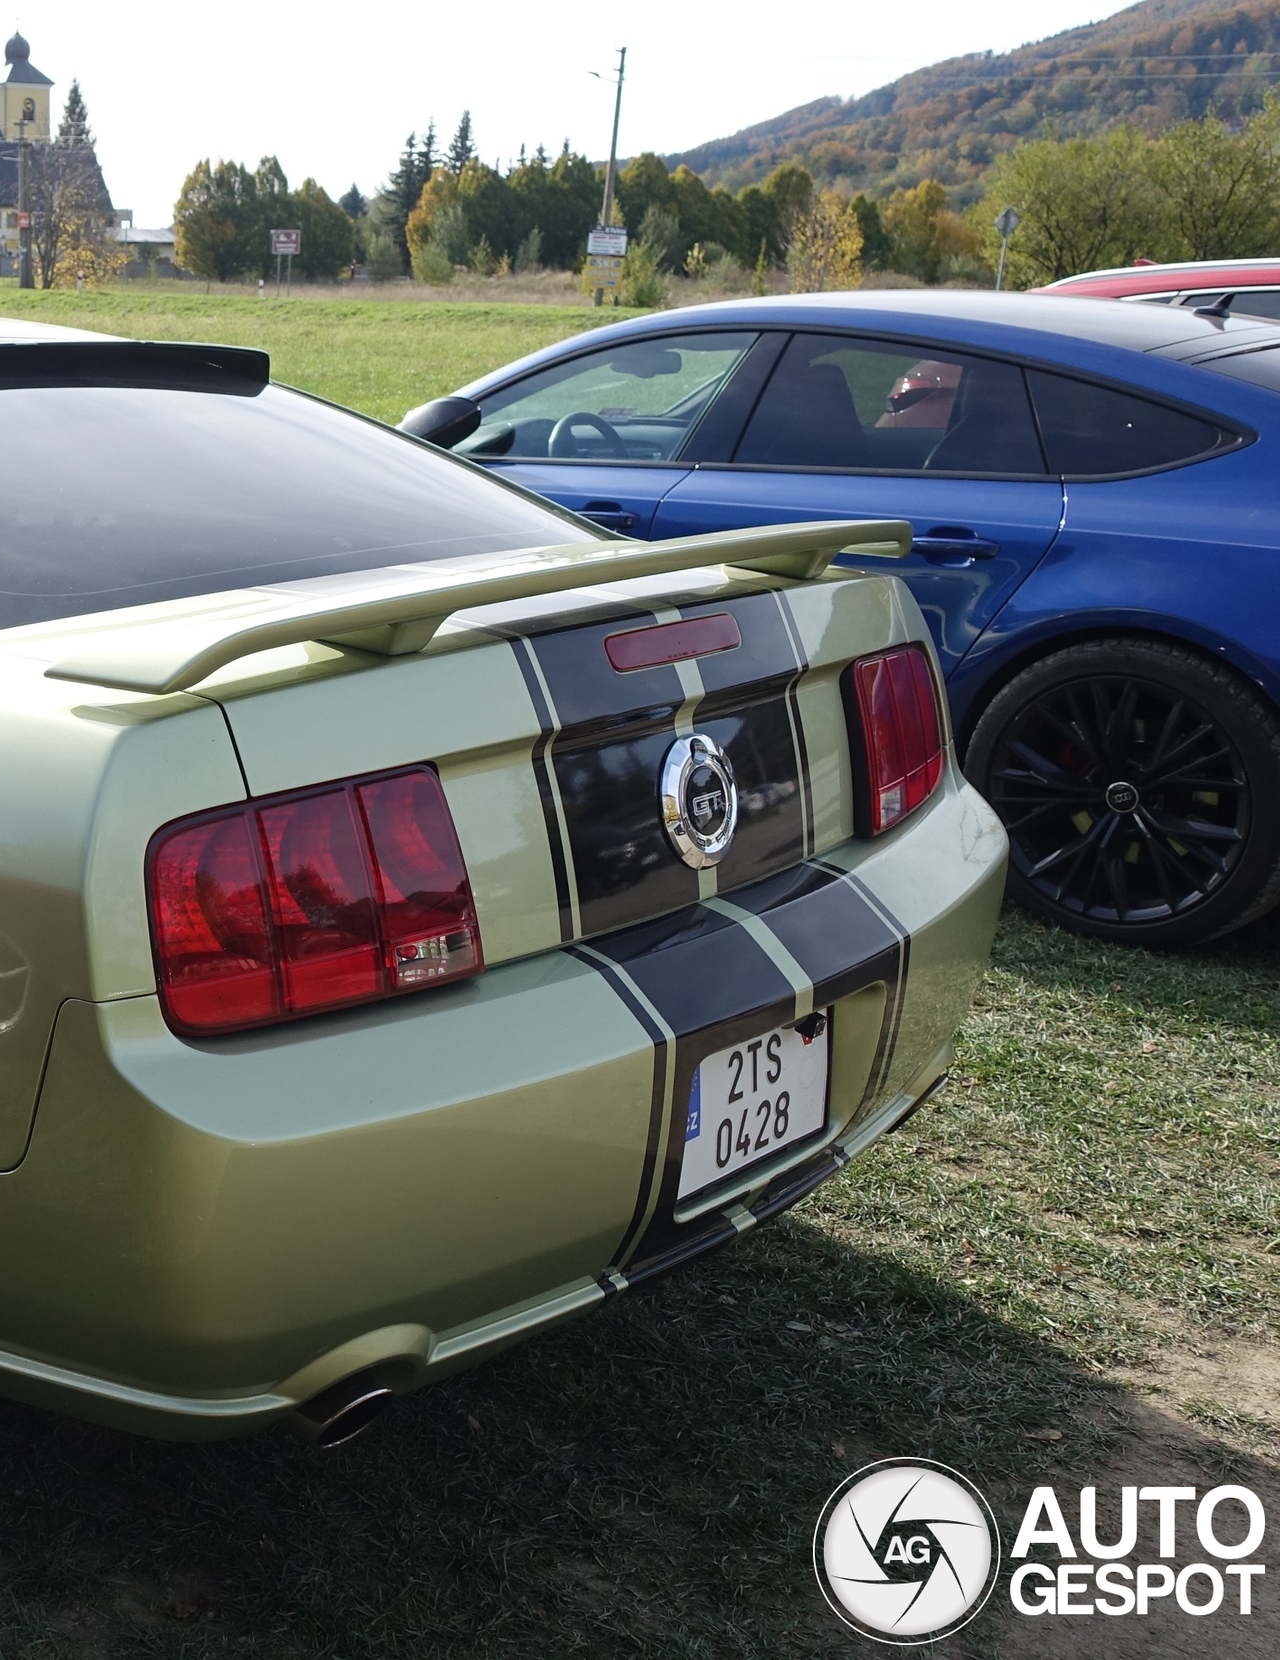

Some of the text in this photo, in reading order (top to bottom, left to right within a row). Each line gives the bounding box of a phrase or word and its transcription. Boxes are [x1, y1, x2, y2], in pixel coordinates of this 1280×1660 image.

[692, 789, 723, 816] GT
[728, 1034, 782, 1104] 2TS
[716, 1091, 790, 1168] 0428
